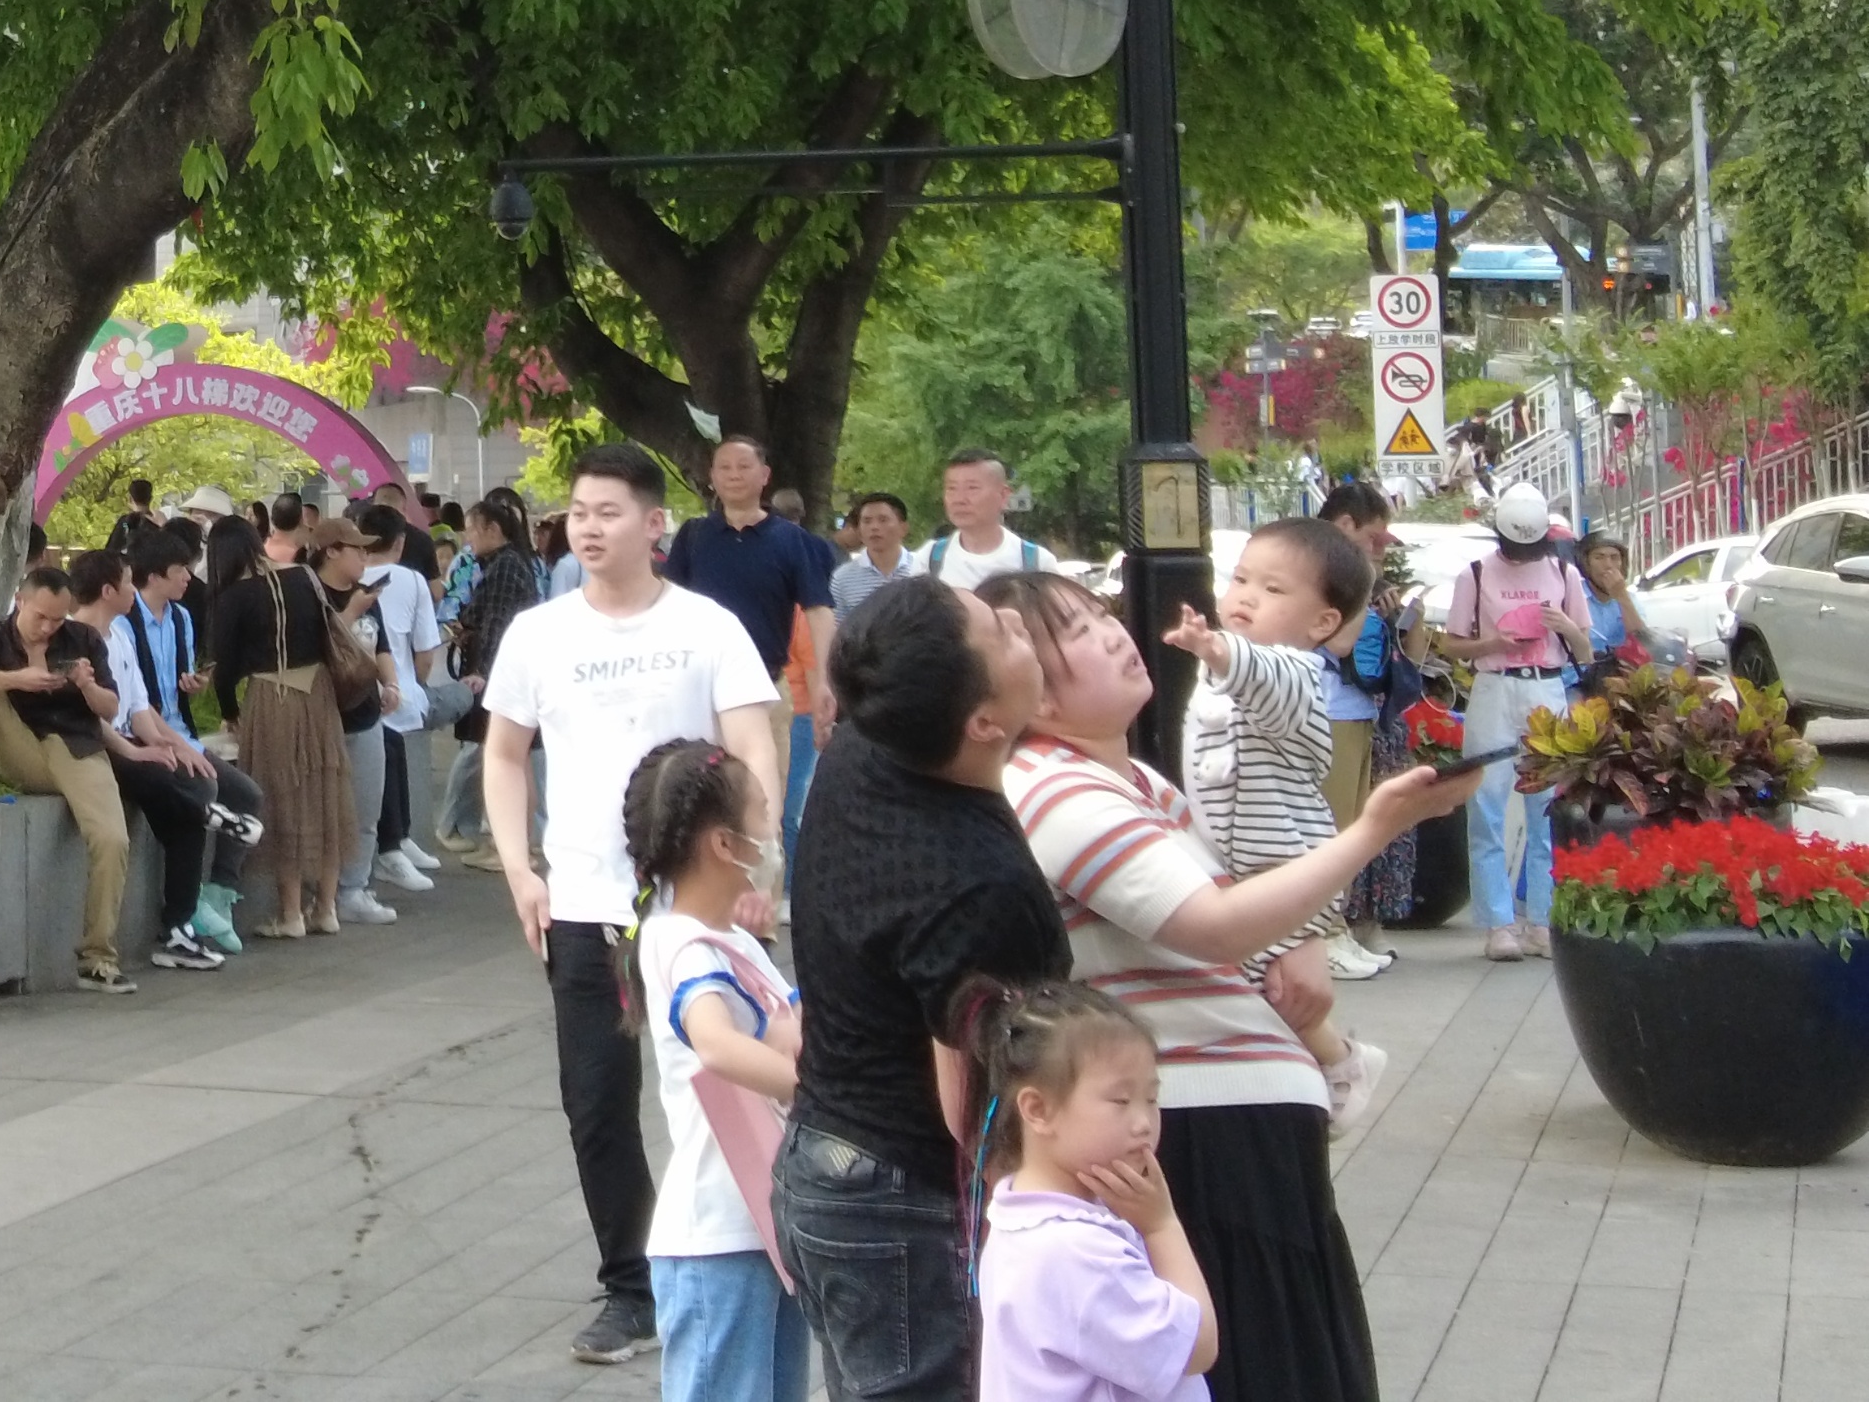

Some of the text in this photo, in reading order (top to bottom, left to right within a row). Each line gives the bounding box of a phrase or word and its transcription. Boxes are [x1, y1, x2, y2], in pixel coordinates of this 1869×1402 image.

[1389, 291, 1421, 315] 30
[84, 376, 318, 443] 重庆十八梯欢迎您
[1380, 461, 1442, 475] 学校区域
[573, 650, 694, 683] SMIPLEST
